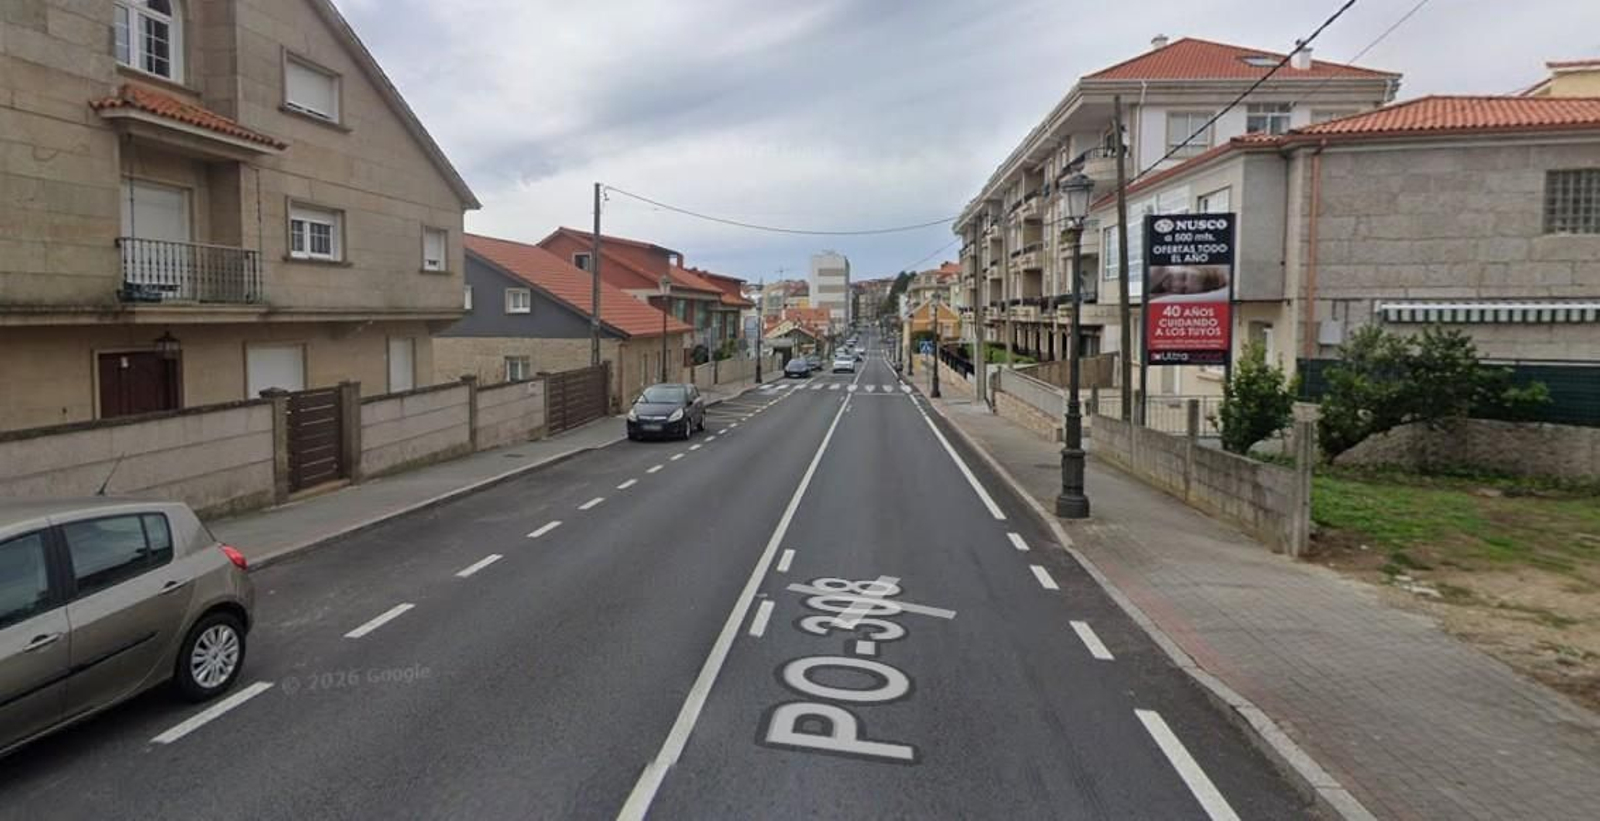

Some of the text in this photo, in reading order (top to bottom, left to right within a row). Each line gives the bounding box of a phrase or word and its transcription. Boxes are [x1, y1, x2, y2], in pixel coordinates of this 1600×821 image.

[1175, 219, 1227, 230] NUSCO
[1164, 234, 1173, 242] a
[1153, 243, 1228, 254] OFERTAS TODO
[1162, 305, 1215, 317] 40 AÑOS
[1158, 317, 1218, 328] CUIDANDO
[1155, 327, 1221, 337] A LOS TUYOS
